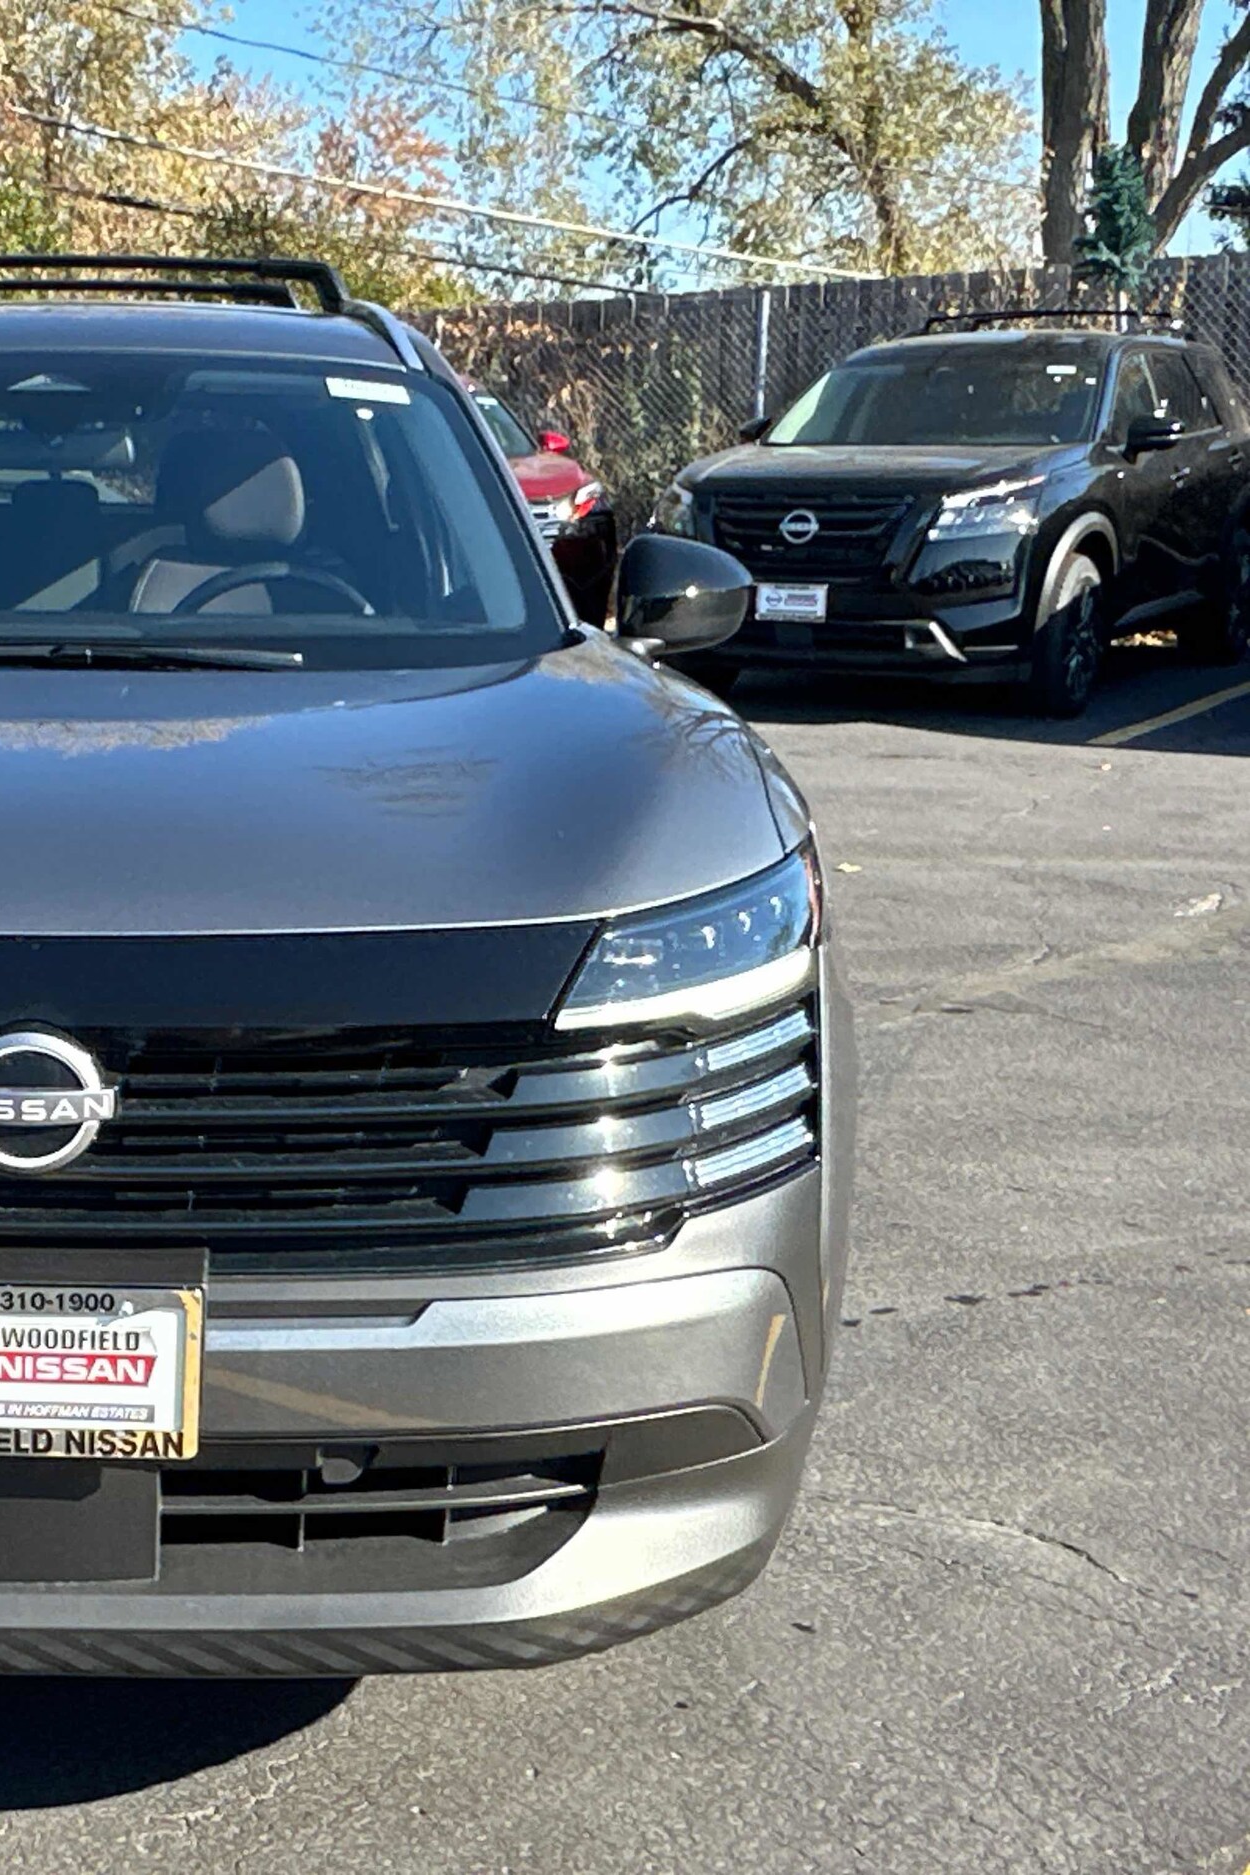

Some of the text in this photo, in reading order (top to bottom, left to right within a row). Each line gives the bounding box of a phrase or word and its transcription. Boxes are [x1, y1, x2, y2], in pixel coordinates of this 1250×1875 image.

[0, 1290, 116, 1312] 310-1900
[1, 1326, 140, 1351] WOODFIELD
[23, 1403, 89, 1418] HOFFMAN
[91, 1405, 149, 1420] ESTATES
[65, 1429, 184, 1458] NISSAN
